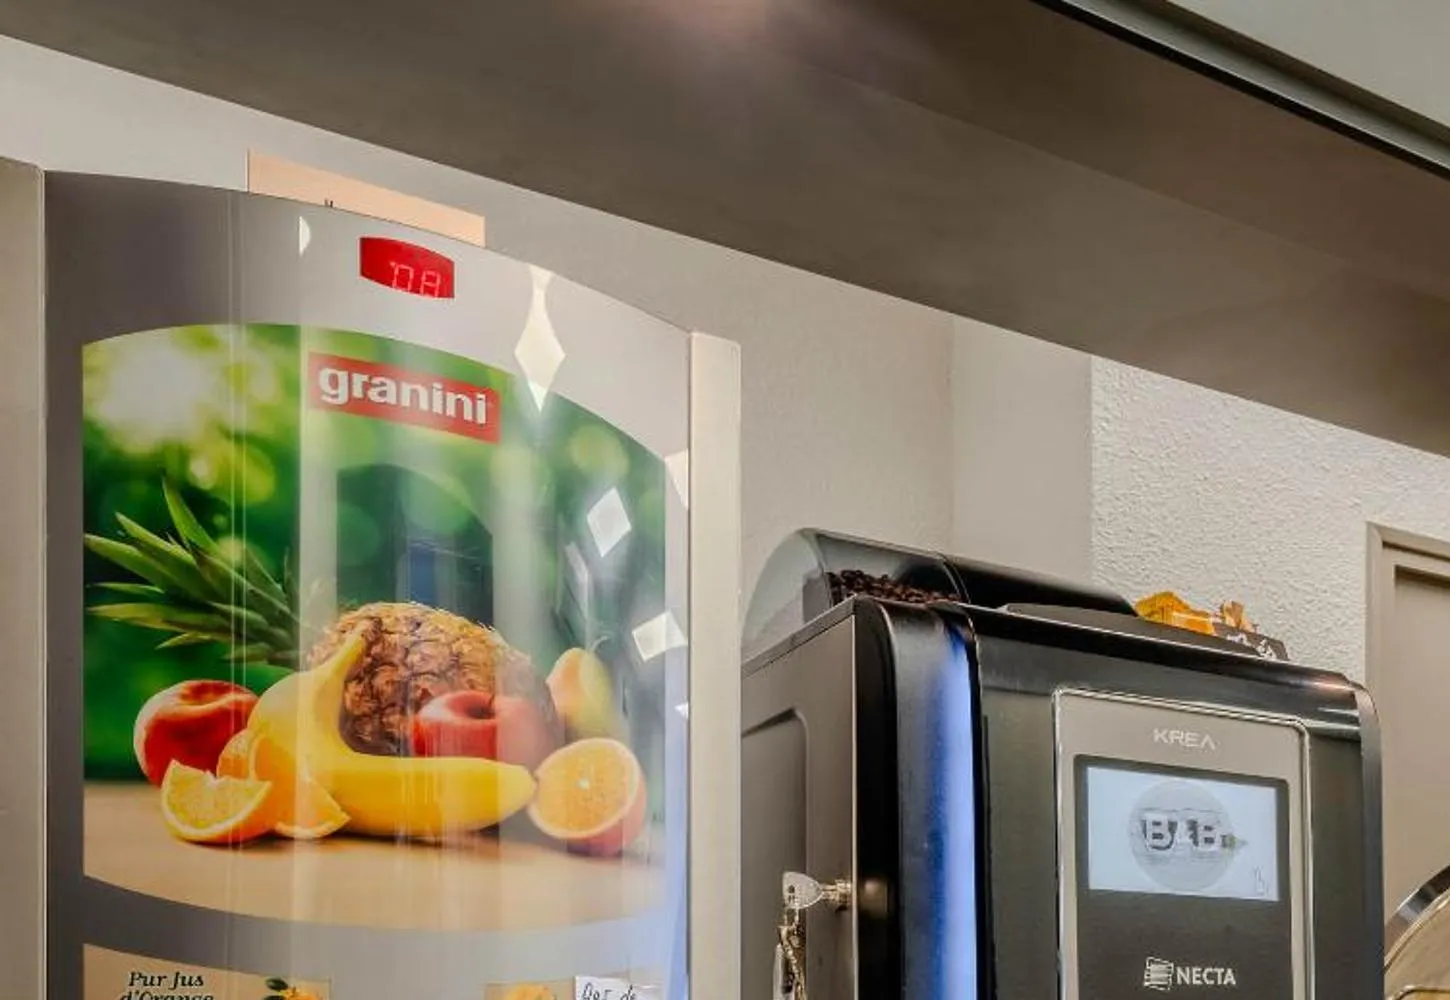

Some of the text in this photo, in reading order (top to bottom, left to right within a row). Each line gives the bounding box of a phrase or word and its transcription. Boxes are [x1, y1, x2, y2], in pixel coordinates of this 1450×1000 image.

[318, 367, 487, 425] granini
[1153, 727, 1217, 751] KREA
[128, 971, 205, 991] Pur Jus
[1176, 967, 1237, 986] NECTA
